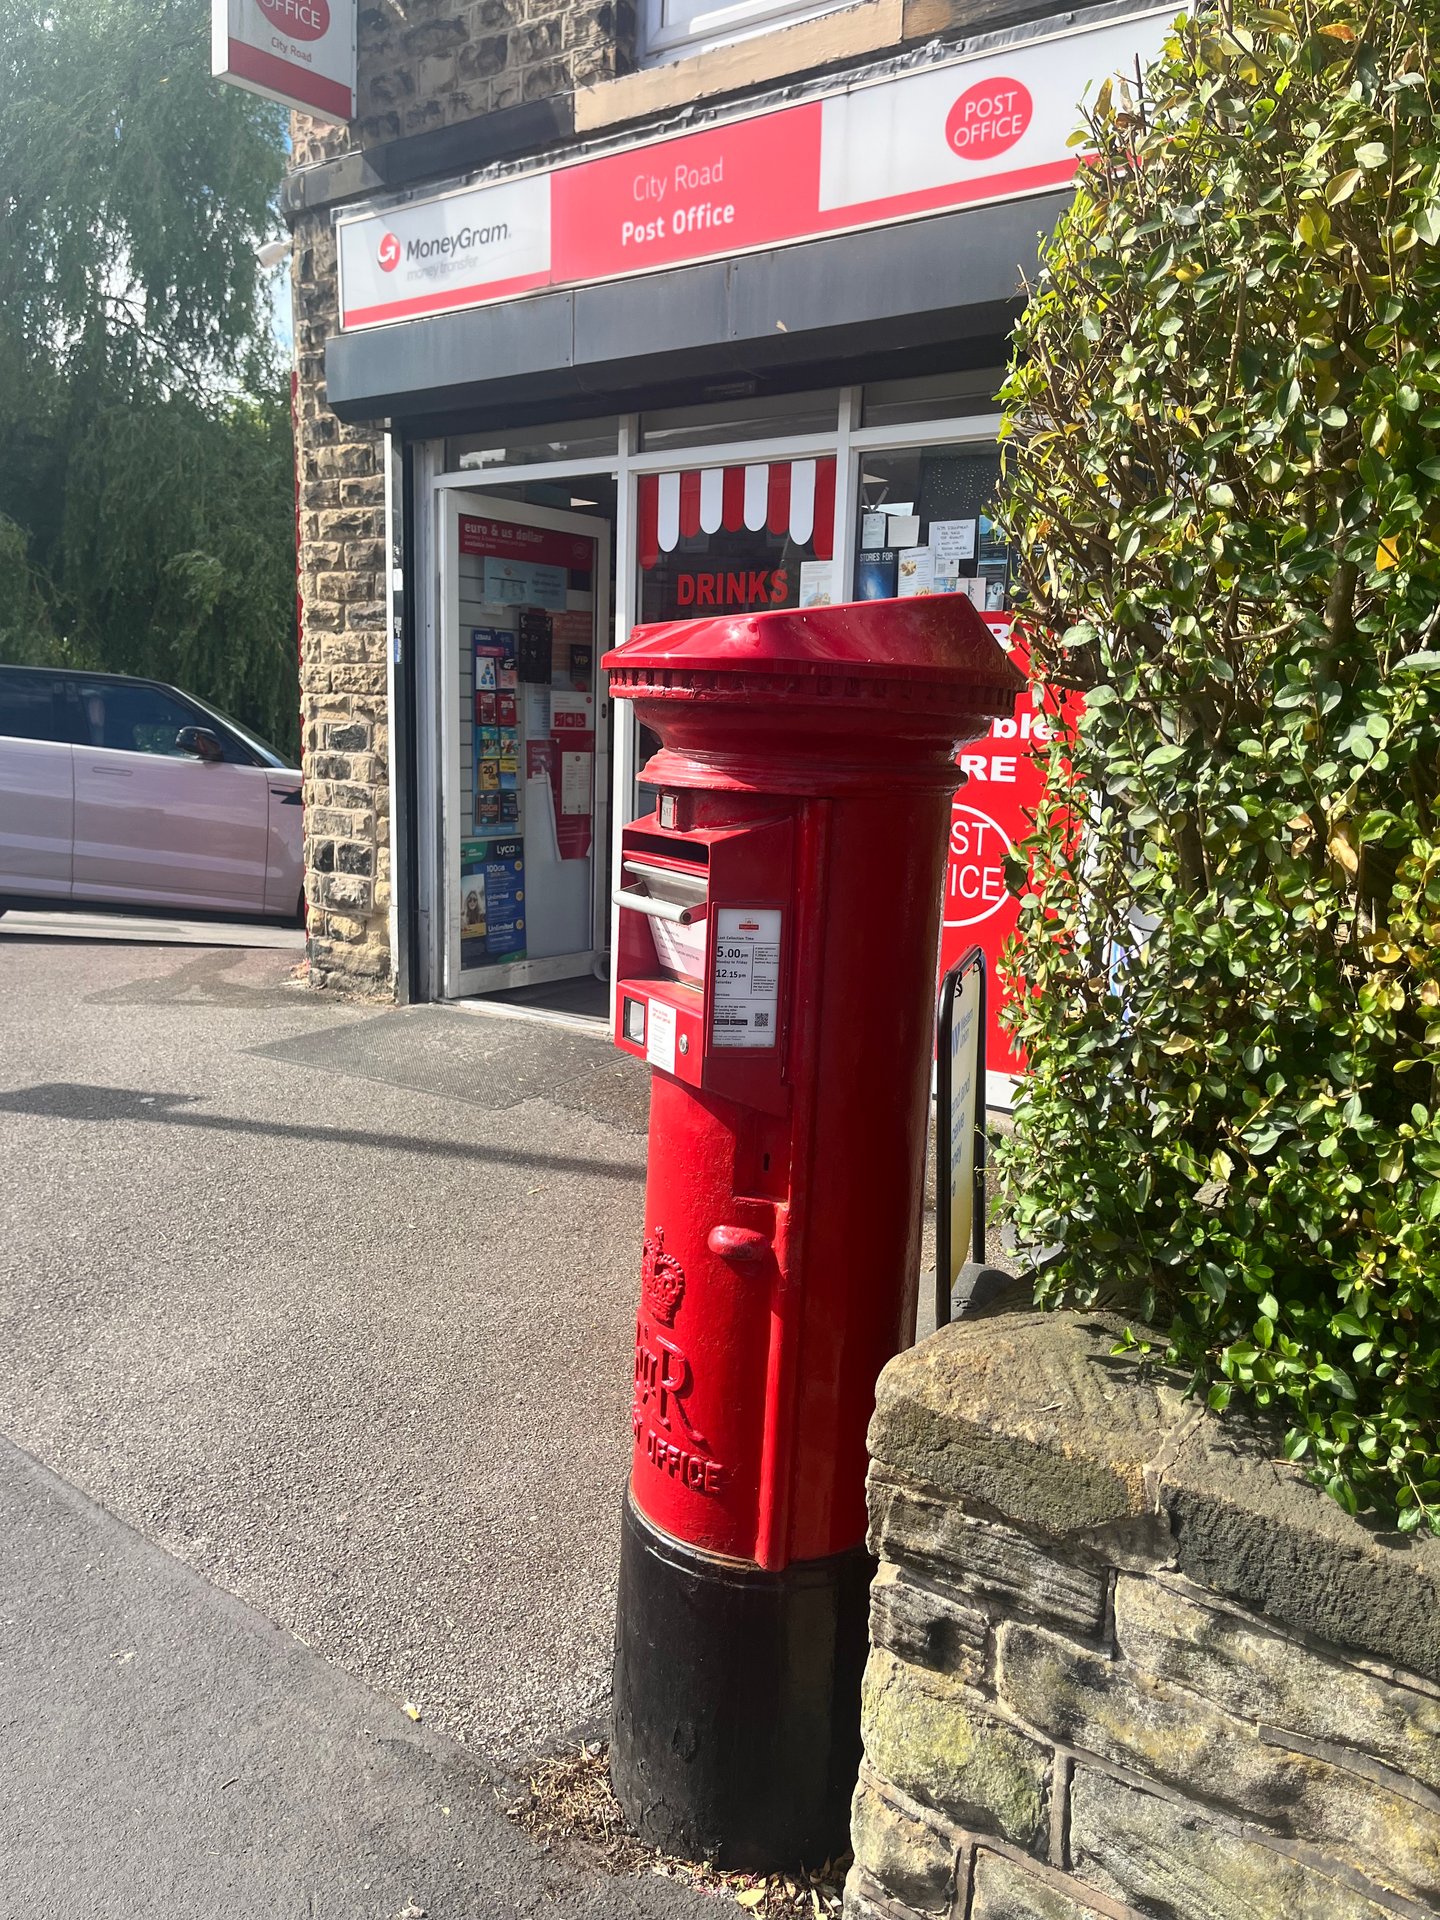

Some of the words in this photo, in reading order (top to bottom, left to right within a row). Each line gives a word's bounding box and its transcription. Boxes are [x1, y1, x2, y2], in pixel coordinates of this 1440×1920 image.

[271, 36, 288, 54] City
[290, 45, 312, 63] Road
[965, 91, 1018, 122] POST
[954, 114, 1022, 147] OFFICE
[633, 175, 668, 202] City
[675, 155, 723, 192] Road
[622, 216, 665, 247] Post
[672, 202, 735, 235] Office
[406, 223, 508, 261] MoneyGram
[406, 264, 439, 282] money
[440, 254, 478, 274] transfer
[465, 522, 488, 536] euro
[491, 524, 498, 537] &
[501, 528, 513, 539] us
[516, 529, 544, 543] dollar
[859, 552, 880, 562] STORIES
[882, 551, 894, 561] FOR
[677, 569, 789, 606] DRINKS
[496, 845, 516, 856] Lyca
[648, 1428, 724, 1492] OFFICE
